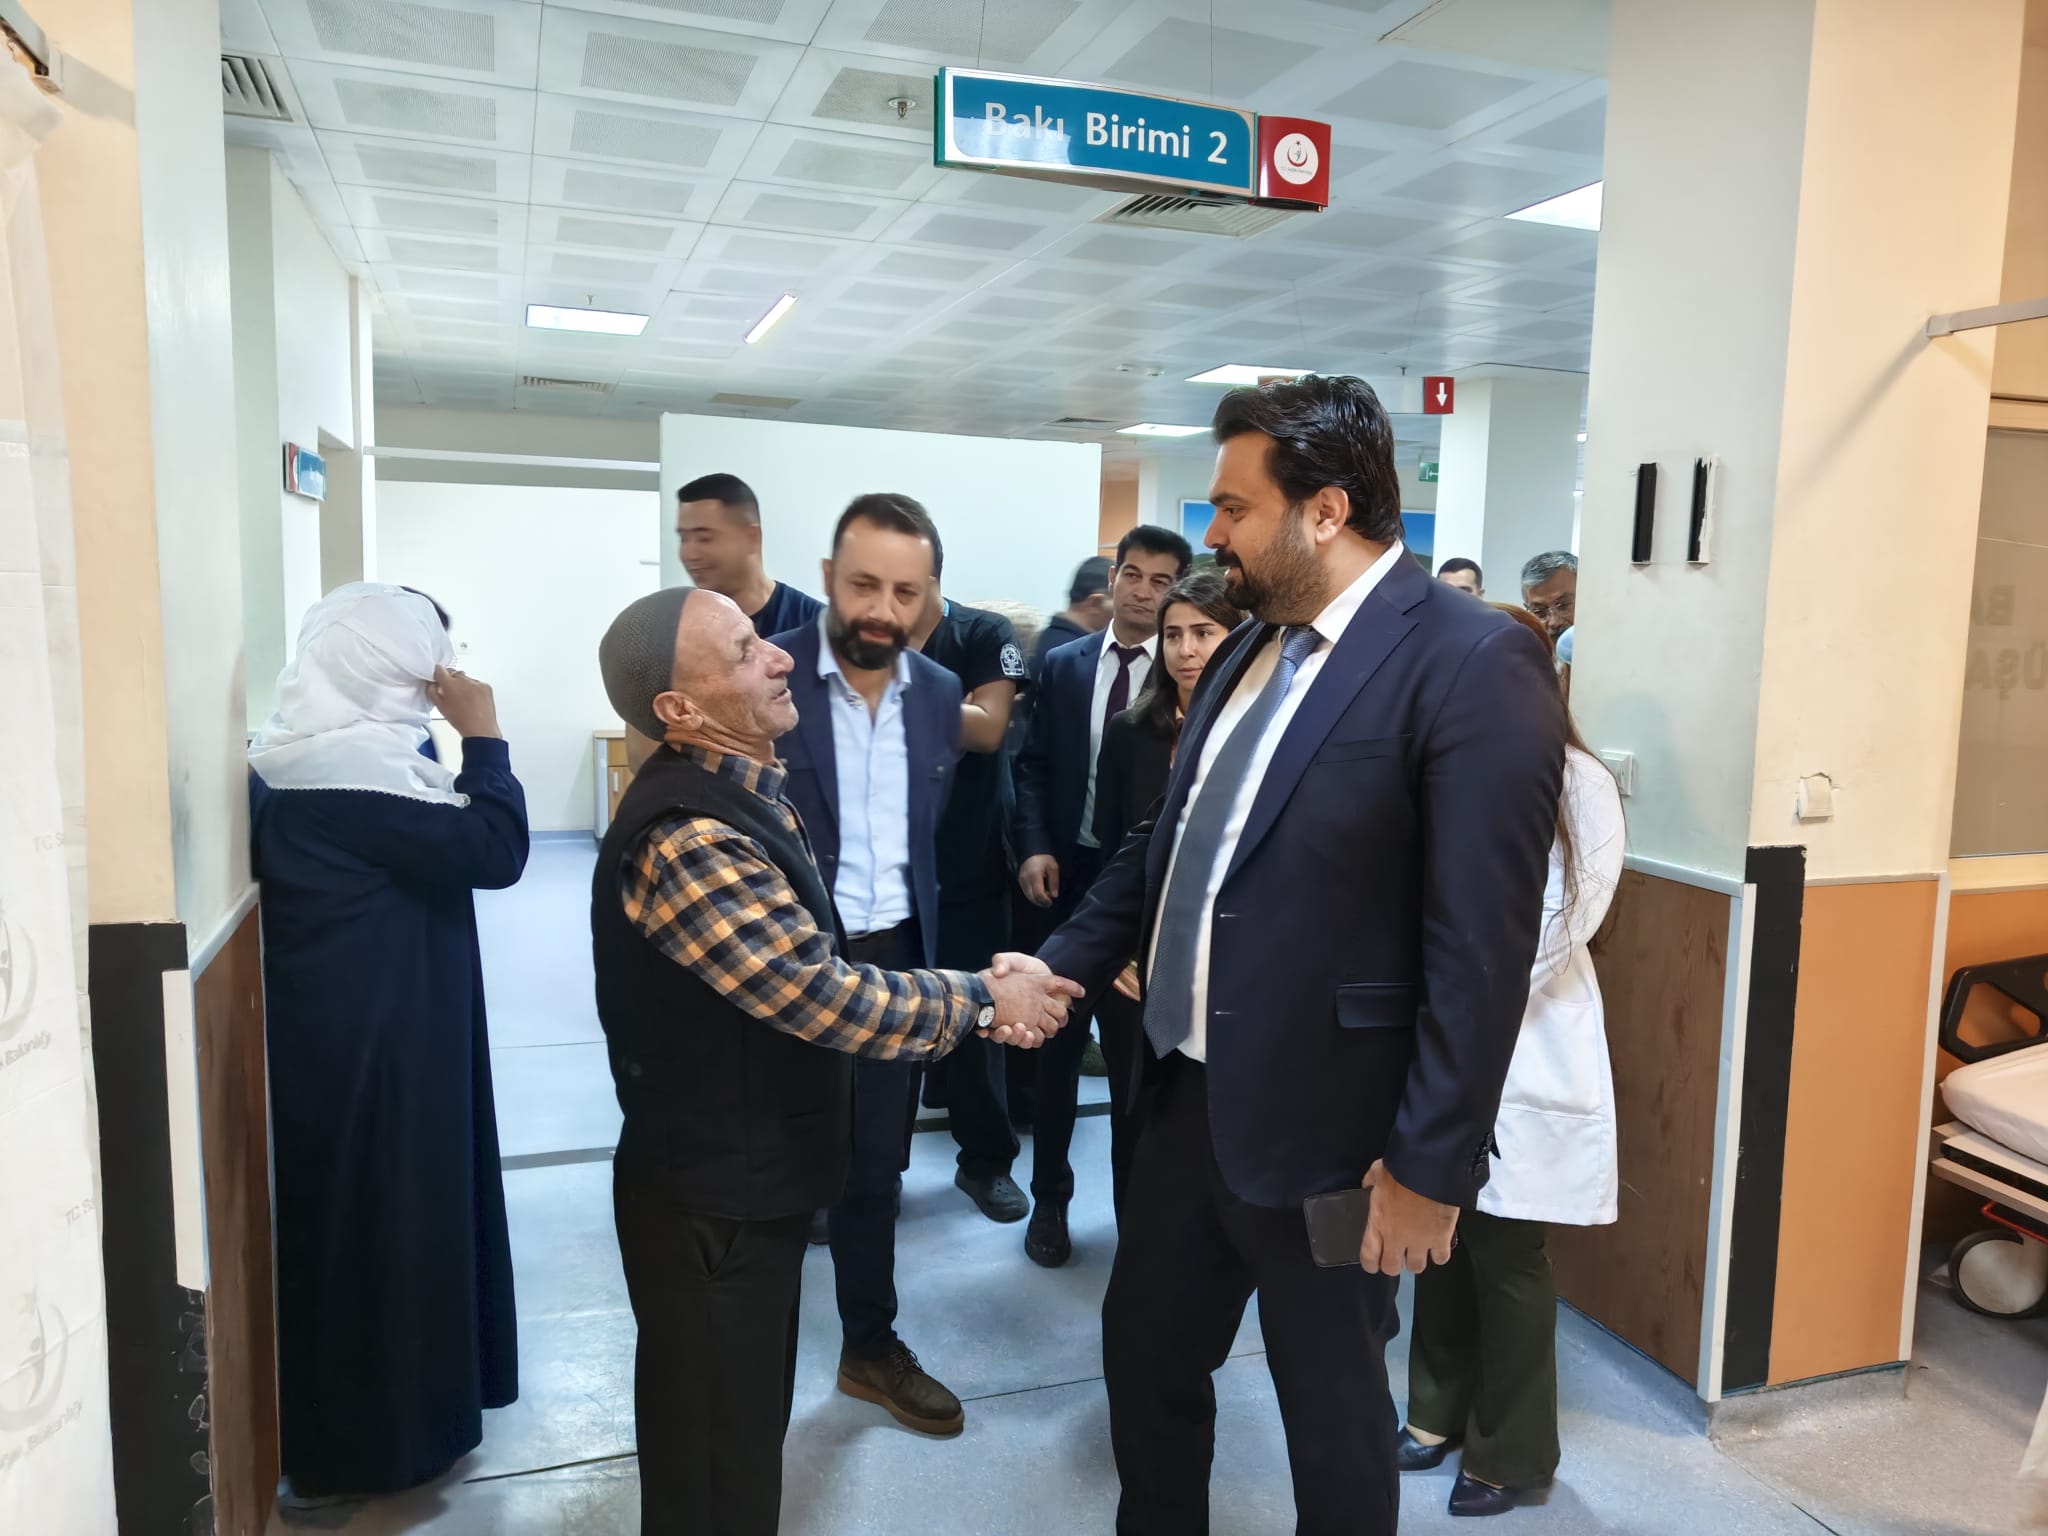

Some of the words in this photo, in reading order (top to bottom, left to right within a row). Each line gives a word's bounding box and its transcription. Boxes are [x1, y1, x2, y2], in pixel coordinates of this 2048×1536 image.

[984, 102, 1064, 142] Bakı
[1086, 112, 1190, 158] Birimi
[1207, 131, 1228, 164] 2
